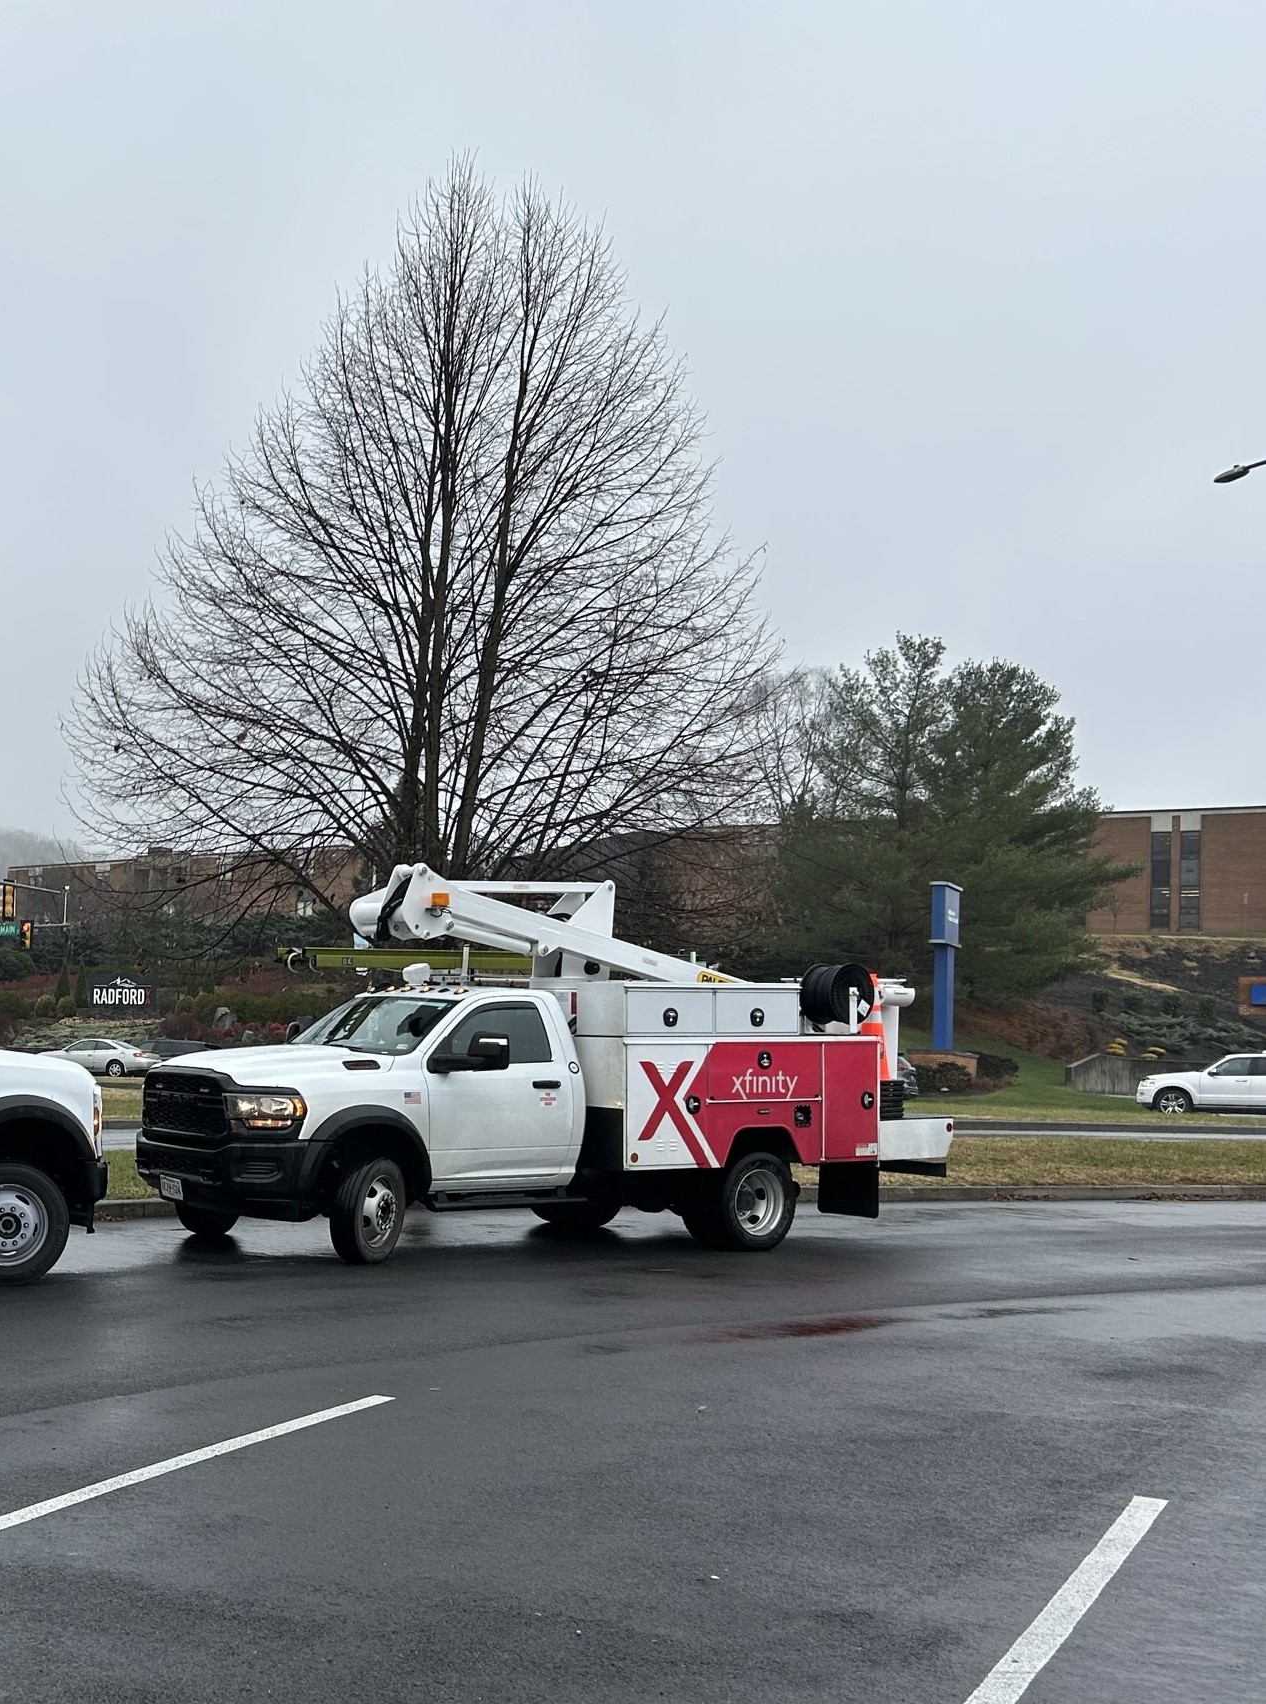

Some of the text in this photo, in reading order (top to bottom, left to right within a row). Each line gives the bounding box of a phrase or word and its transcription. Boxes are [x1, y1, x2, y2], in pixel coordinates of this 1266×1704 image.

[0, 924, 16, 935] MAIN
[93, 988, 145, 1005] RADFORD
[731, 1068, 798, 1100] xfinity
